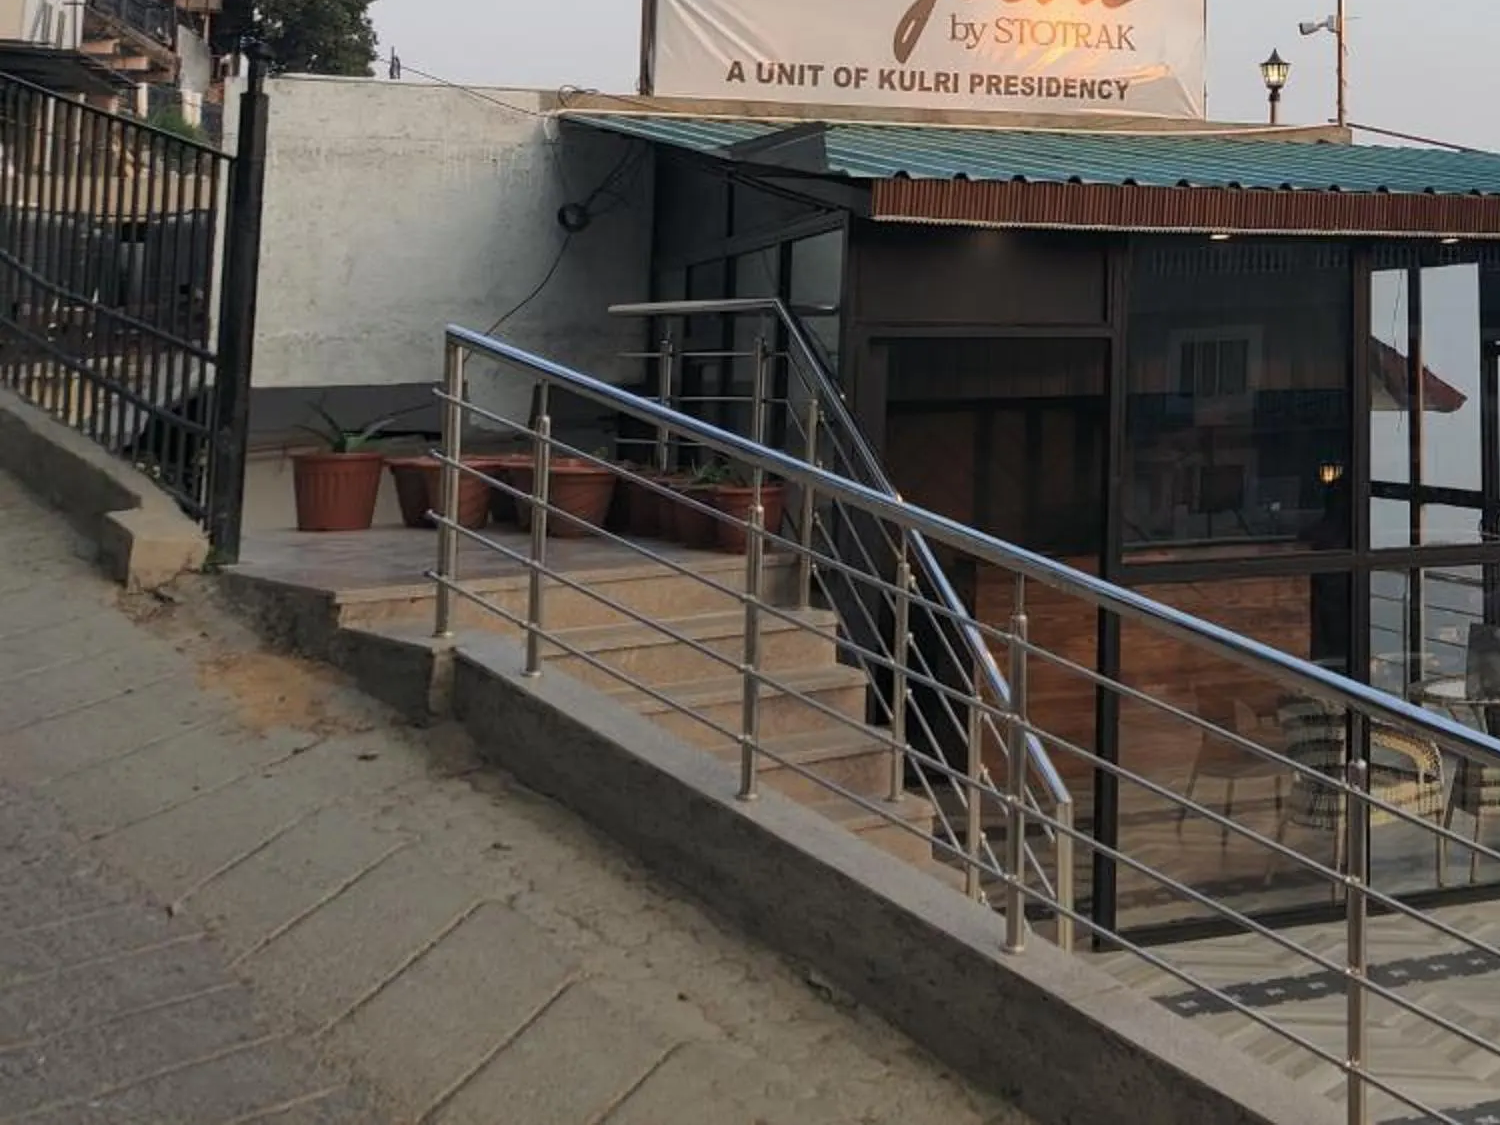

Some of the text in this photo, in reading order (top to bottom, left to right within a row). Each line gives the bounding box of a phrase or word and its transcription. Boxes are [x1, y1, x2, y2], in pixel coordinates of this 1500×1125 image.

[949, 13, 1136, 51] by STOTRAK
[725, 61, 1130, 100] A UNIT OF KULRI PRESIDENCY
